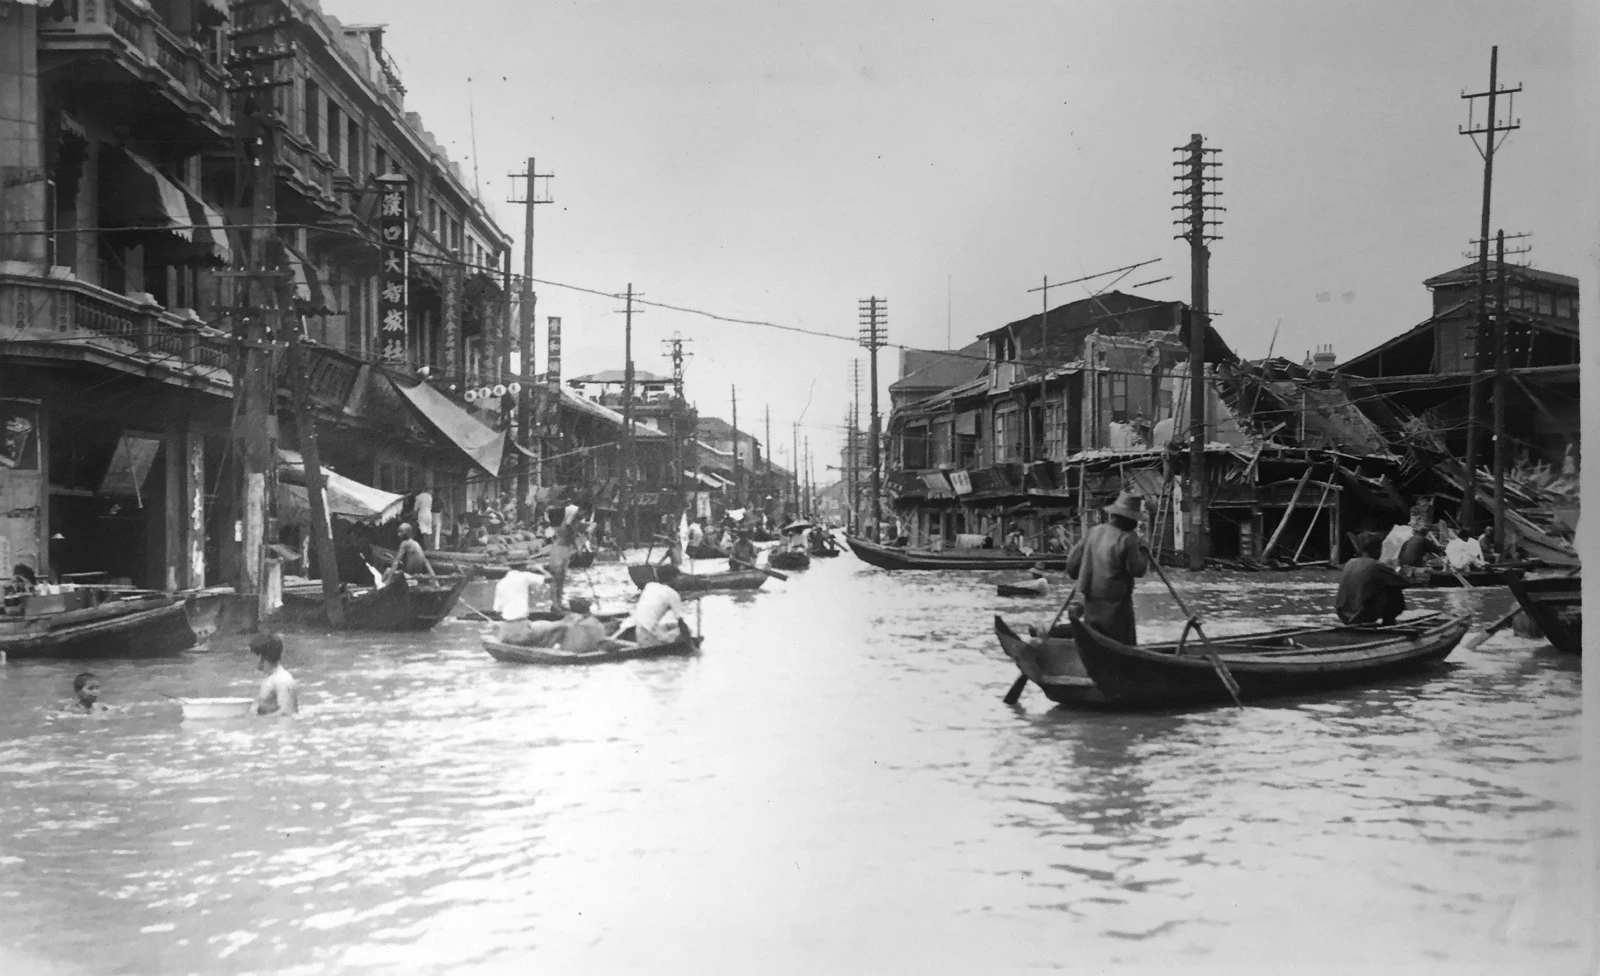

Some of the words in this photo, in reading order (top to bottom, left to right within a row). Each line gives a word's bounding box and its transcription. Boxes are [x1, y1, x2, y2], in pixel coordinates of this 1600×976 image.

[382, 192, 404, 361] 漢口大智旅社
